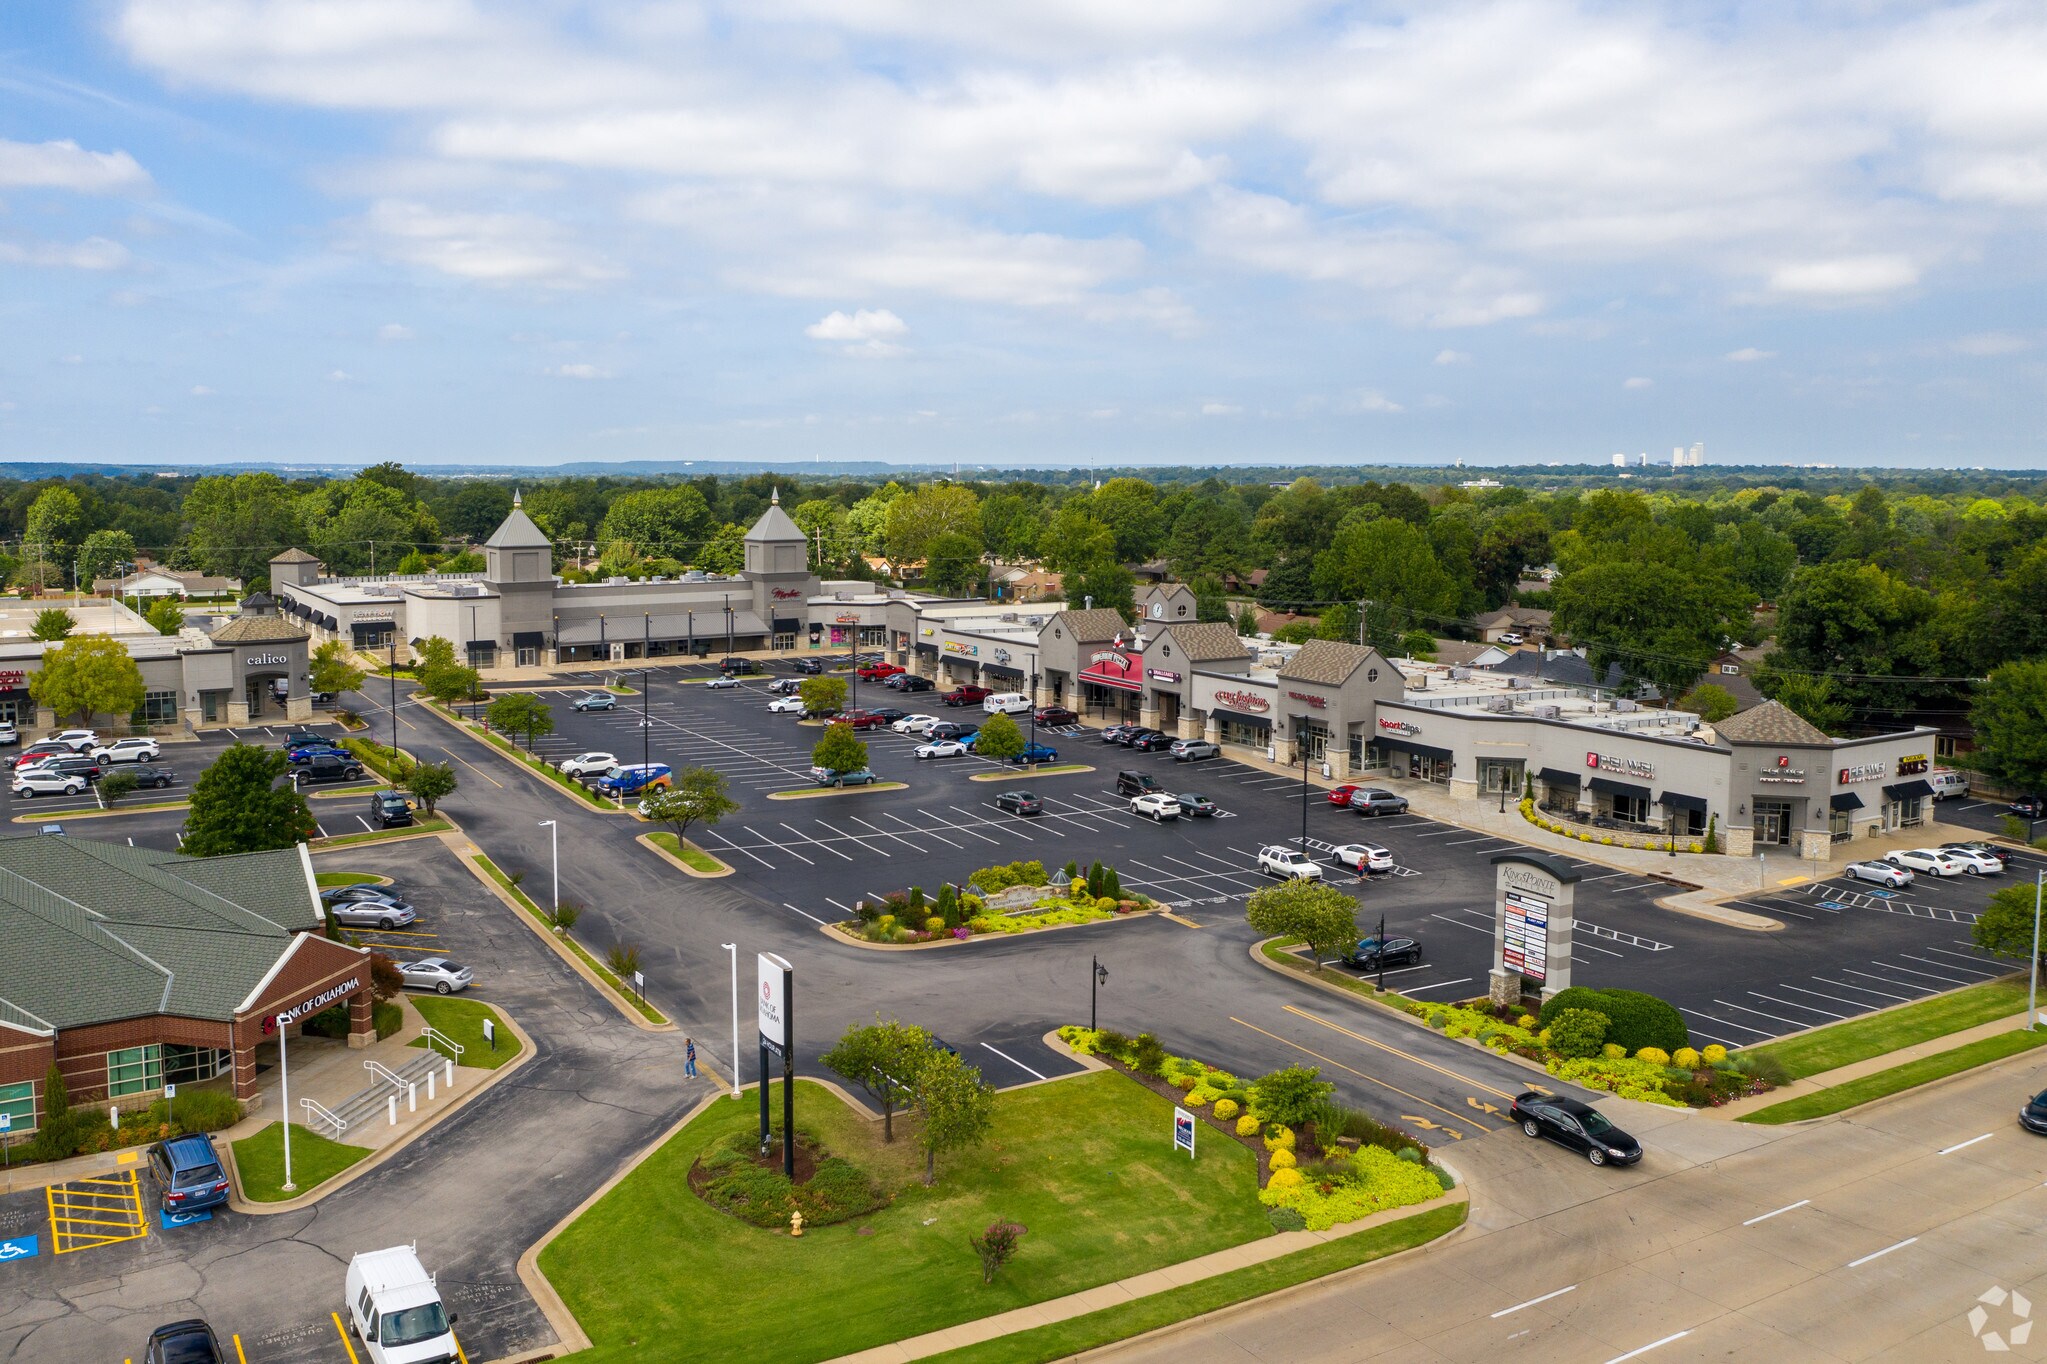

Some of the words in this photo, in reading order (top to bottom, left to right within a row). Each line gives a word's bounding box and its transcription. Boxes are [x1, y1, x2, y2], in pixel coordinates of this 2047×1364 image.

[247, 653, 287, 665] calico
[277, 1005, 302, 1027] NK
[302, 999, 314, 1013] OF
[314, 977, 360, 1008] OKLAHOMA
